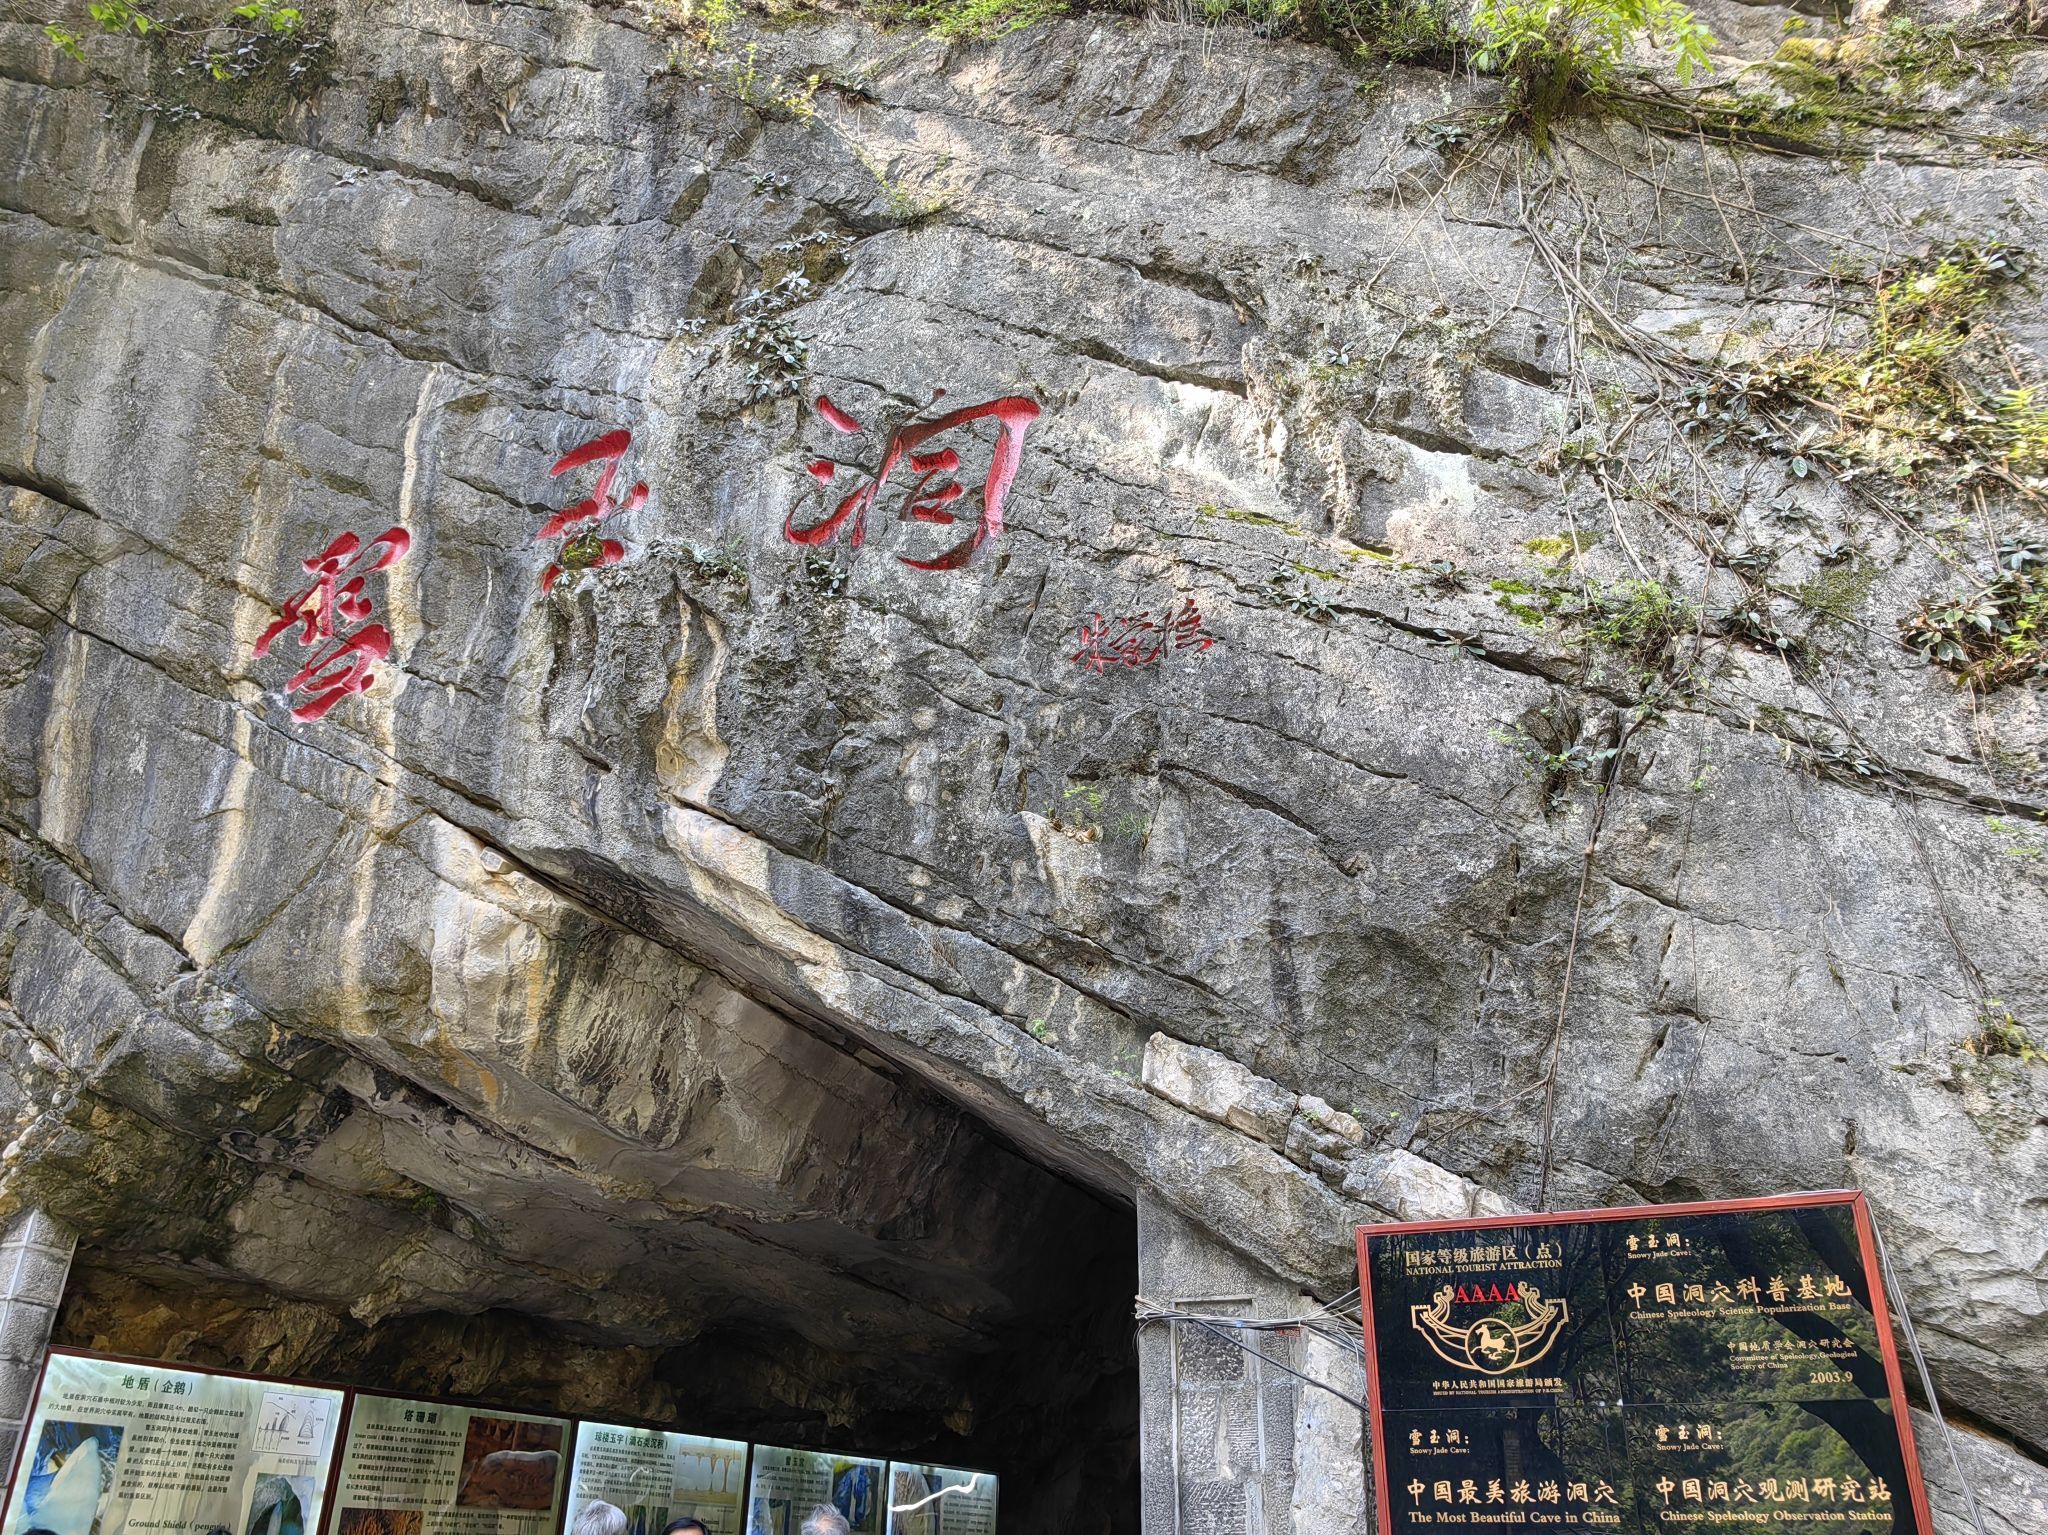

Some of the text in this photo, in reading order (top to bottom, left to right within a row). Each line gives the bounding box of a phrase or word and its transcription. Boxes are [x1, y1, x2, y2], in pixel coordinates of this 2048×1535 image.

[1627, 1252, 1651, 1260] Snowy
[1652, 1251, 1669, 1259] Jade
[1406, 1259, 1563, 1276] NATIONAL TOURIST ATTRACTION
[1455, 1282, 1520, 1304] AAAA
[1626, 1273, 1853, 1309] 中国洞穴科普基地
[1629, 1302, 1851, 1320] Chinese Speleology Science Popularization Base
[1770, 1353, 1779, 1361] of
[1730, 1361, 1789, 1371] Society of China
[1809, 1371, 1854, 1384] 2003.9
[1410, 1447, 1433, 1456] Snowy
[1433, 1447, 1448, 1455] Jade
[1656, 1443, 1682, 1452] Snowy
[1683, 1443, 1700, 1451] Jade
[1407, 1478, 1619, 1506] 中国最美旅游洞穴
[1656, 1475, 1892, 1505] 中国洞穴观测研究站
[1408, 1511, 1621, 1523] The Most Beautiful Cave in China
[1660, 1510, 1892, 1524] Chinese Speleology Observation Station
[128, 1519, 161, 1528] Ground
[162, 1520, 187, 1529] Shield
